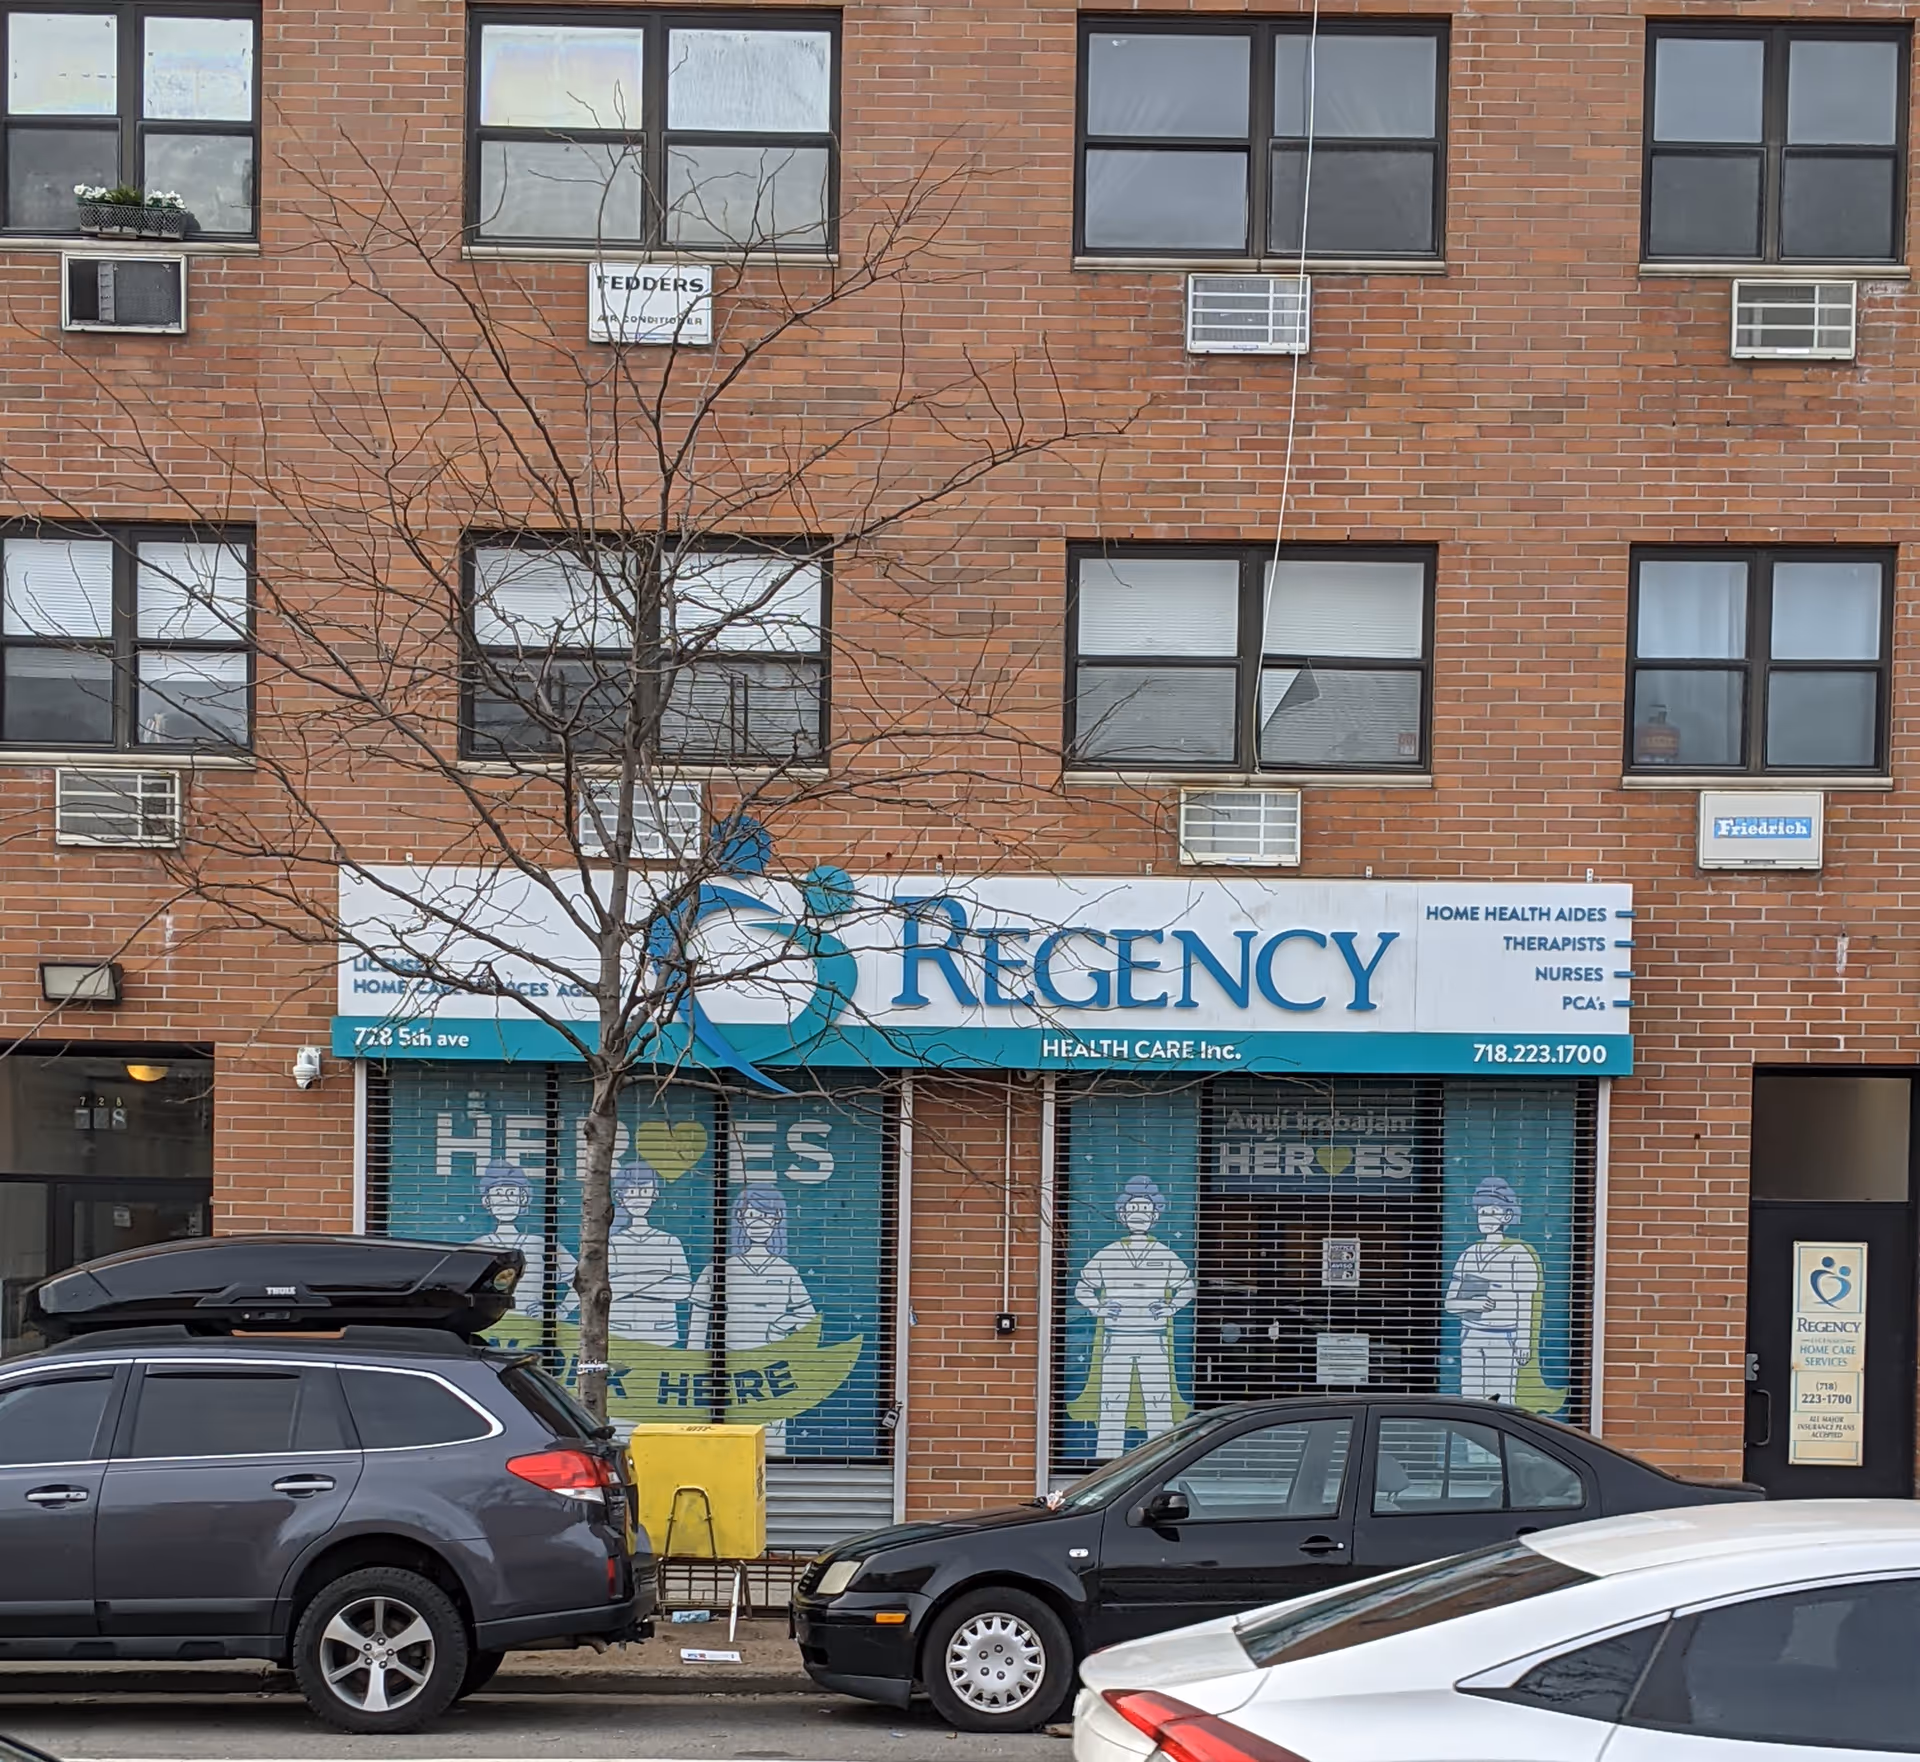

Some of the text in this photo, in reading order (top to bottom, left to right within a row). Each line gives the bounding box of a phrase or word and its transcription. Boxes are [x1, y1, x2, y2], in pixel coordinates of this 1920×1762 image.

[597, 275, 704, 292] FEDDERS
[623, 315, 702, 325] CONDITIOER
[1717, 819, 1808, 836] Friedrich
[1426, 906, 1607, 922] HOME HEALTH AIDES
[1503, 936, 1606, 951] THERAPISTS
[892, 896, 1399, 1011] REGENCY
[1535, 966, 1604, 982] NURSES
[354, 979, 406, 994] HOME
[1562, 996, 1605, 1011] PCA's
[354, 1027, 470, 1047] 728 5th ave
[1043, 1039, 1242, 1060] HEALTH CARE Inc.
[1473, 1043, 1607, 1064] 718.223.1700
[1297, 1109, 1407, 1135] trabajan
[1797, 1317, 1861, 1333] REGENCY
[1800, 1345, 1857, 1355] HOME CARE
[1805, 1357, 1848, 1367] SERVICES
[657, 1360, 799, 1407] HERE
[1816, 1381, 1838, 1391] (718)
[1801, 1393, 1852, 1404] 223-1700
